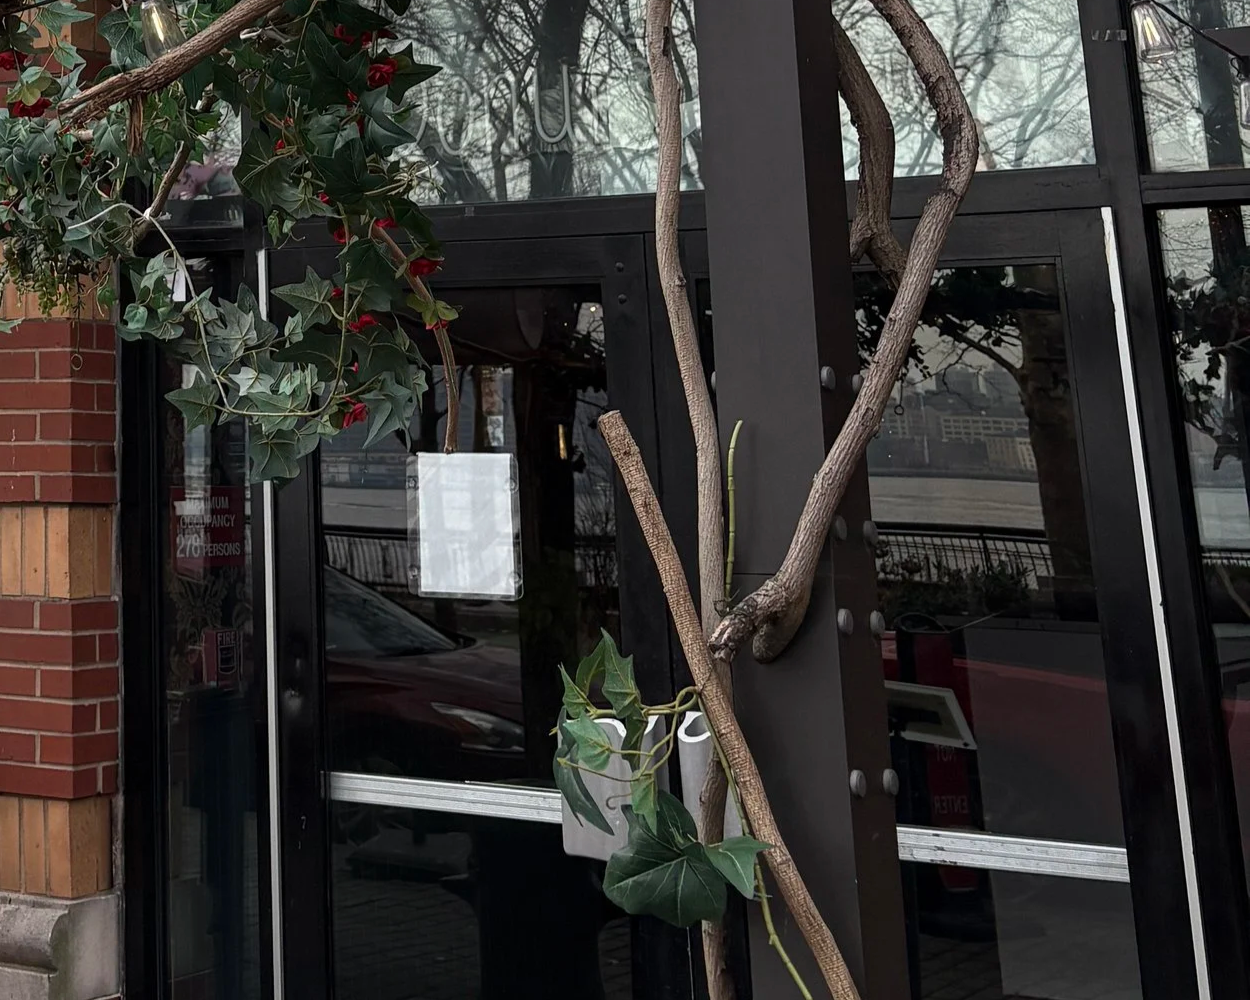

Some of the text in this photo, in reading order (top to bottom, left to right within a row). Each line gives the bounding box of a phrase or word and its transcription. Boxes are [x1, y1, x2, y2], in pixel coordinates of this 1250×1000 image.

[180, 514, 236, 529] OCCUPANCY
[204, 542, 241, 557] PERSONS
[217, 631, 236, 645] FIRE
